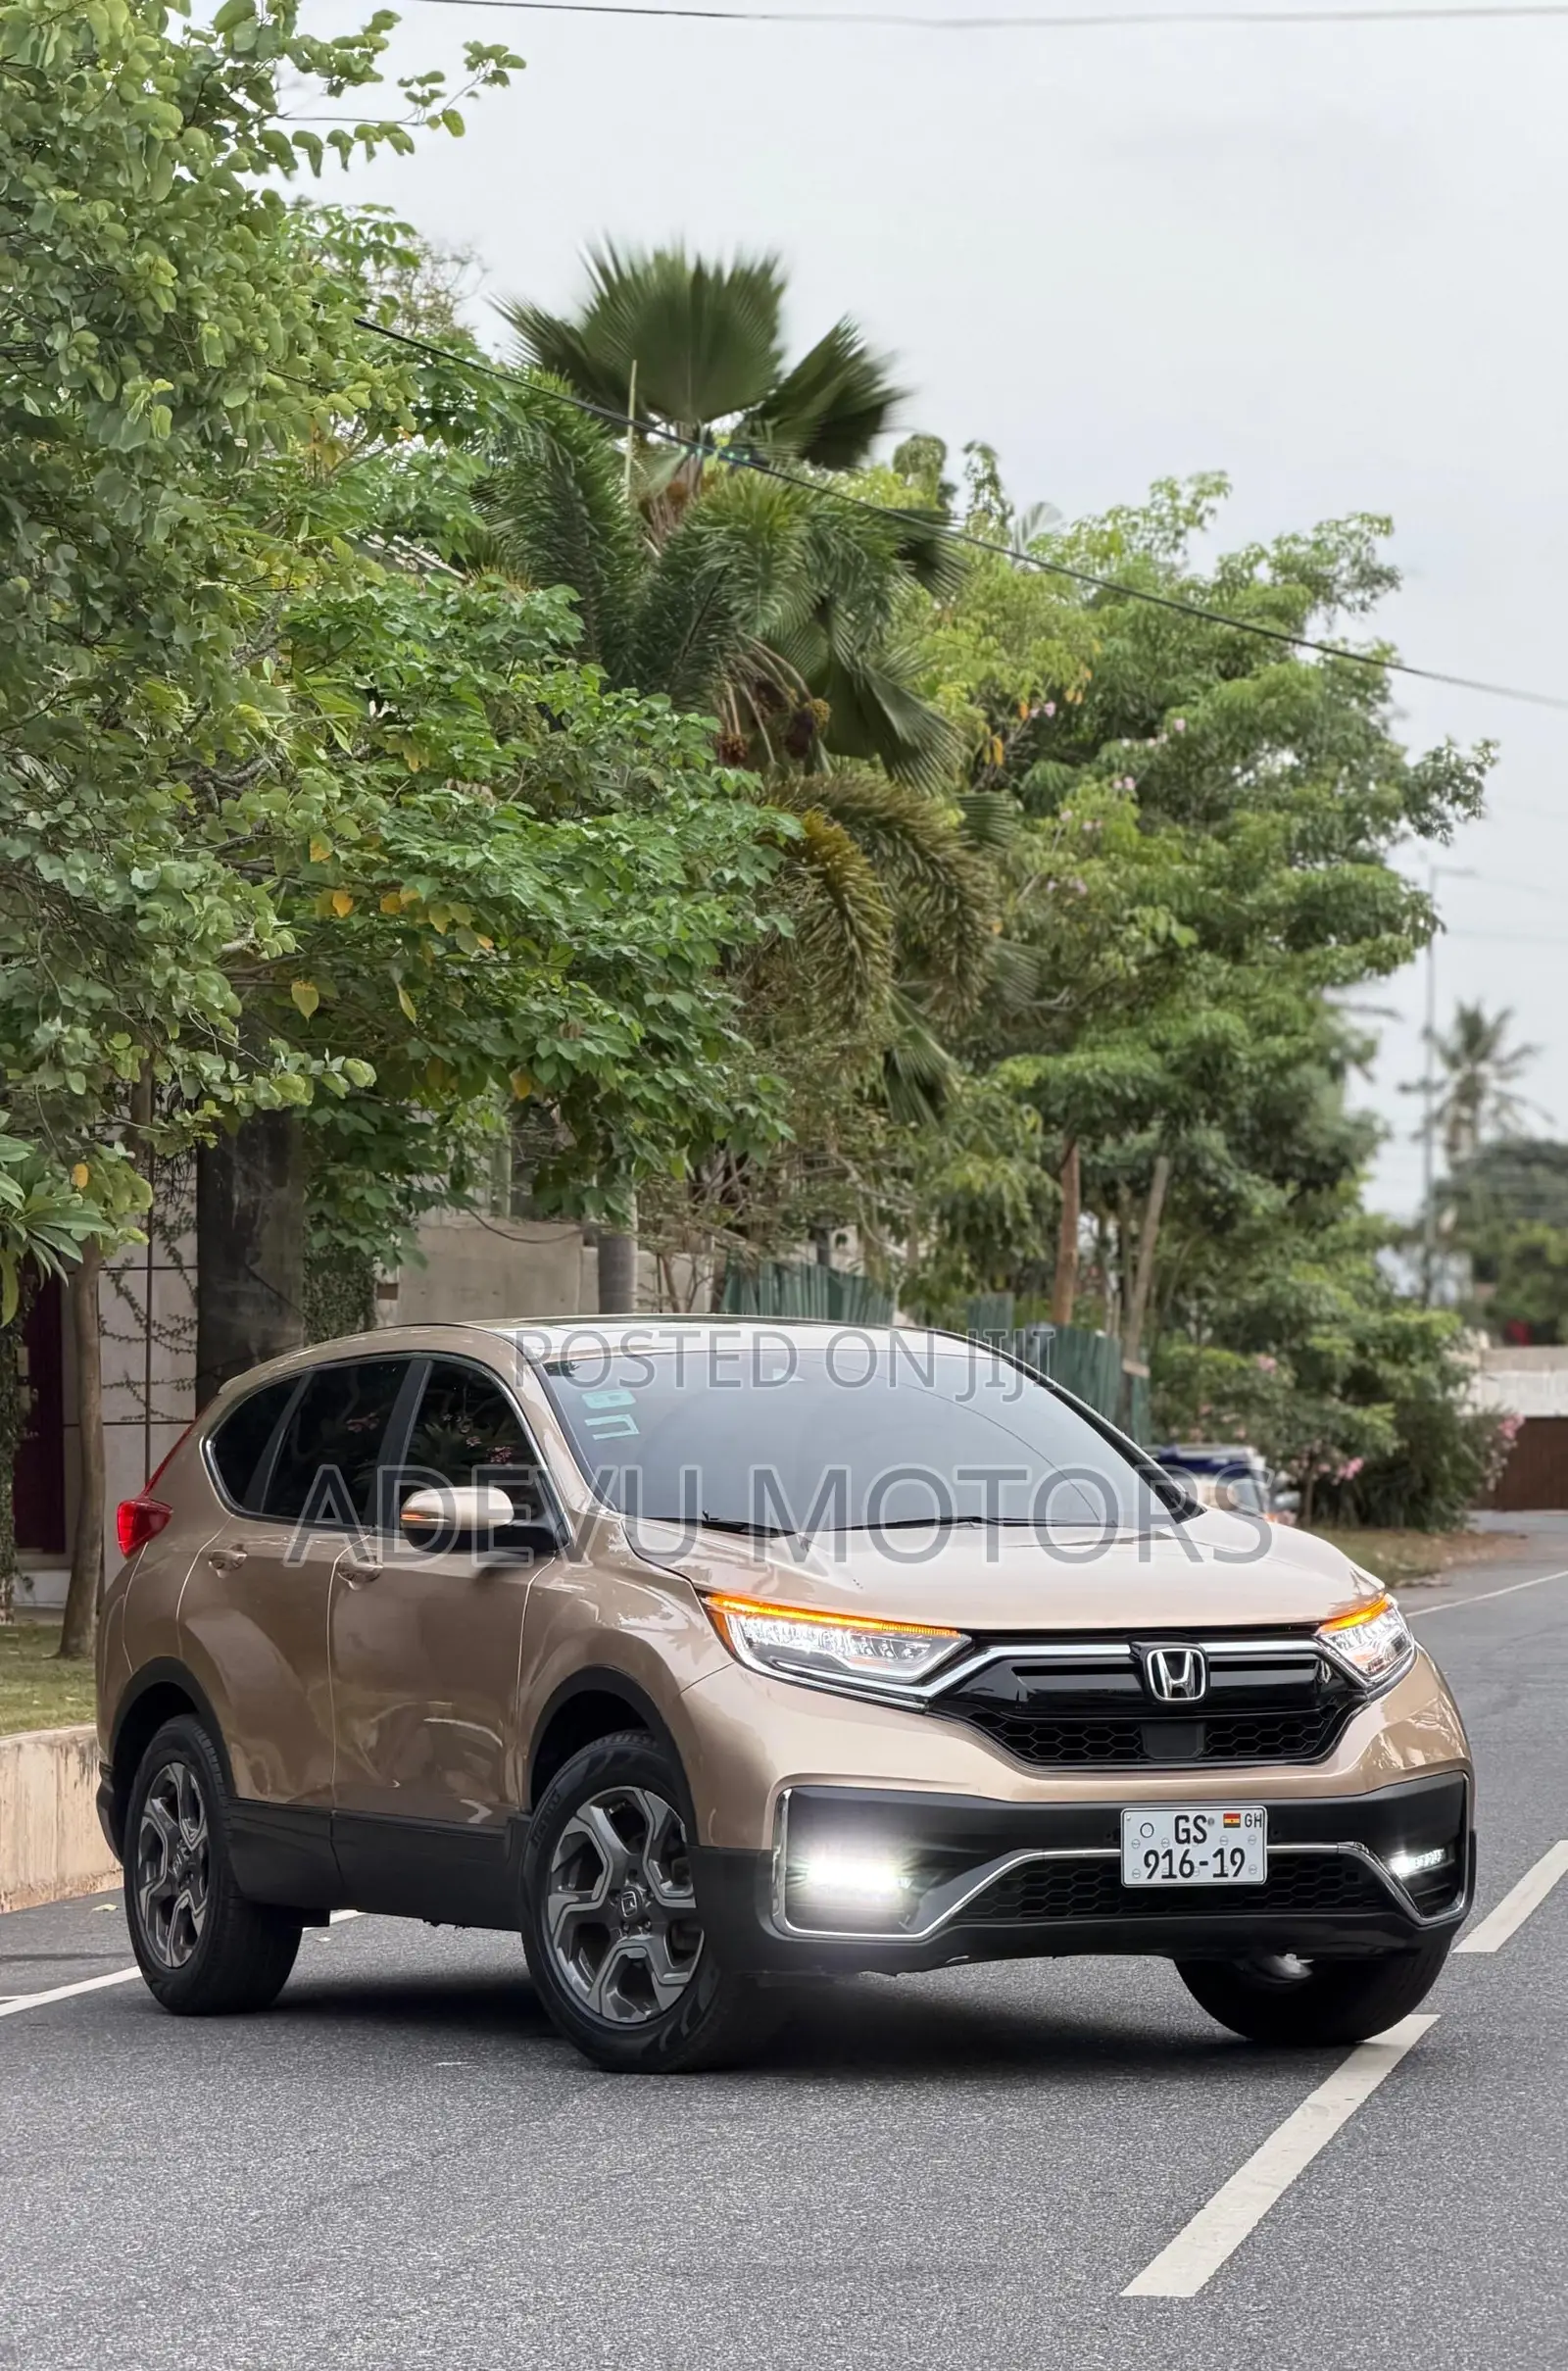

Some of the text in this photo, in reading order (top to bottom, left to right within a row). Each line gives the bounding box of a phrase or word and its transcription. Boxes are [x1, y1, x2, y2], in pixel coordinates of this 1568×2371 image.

[1174, 1814, 1207, 1845] GS
[1244, 1813, 1262, 1828] GH
[1143, 1847, 1246, 1880] 916-19
